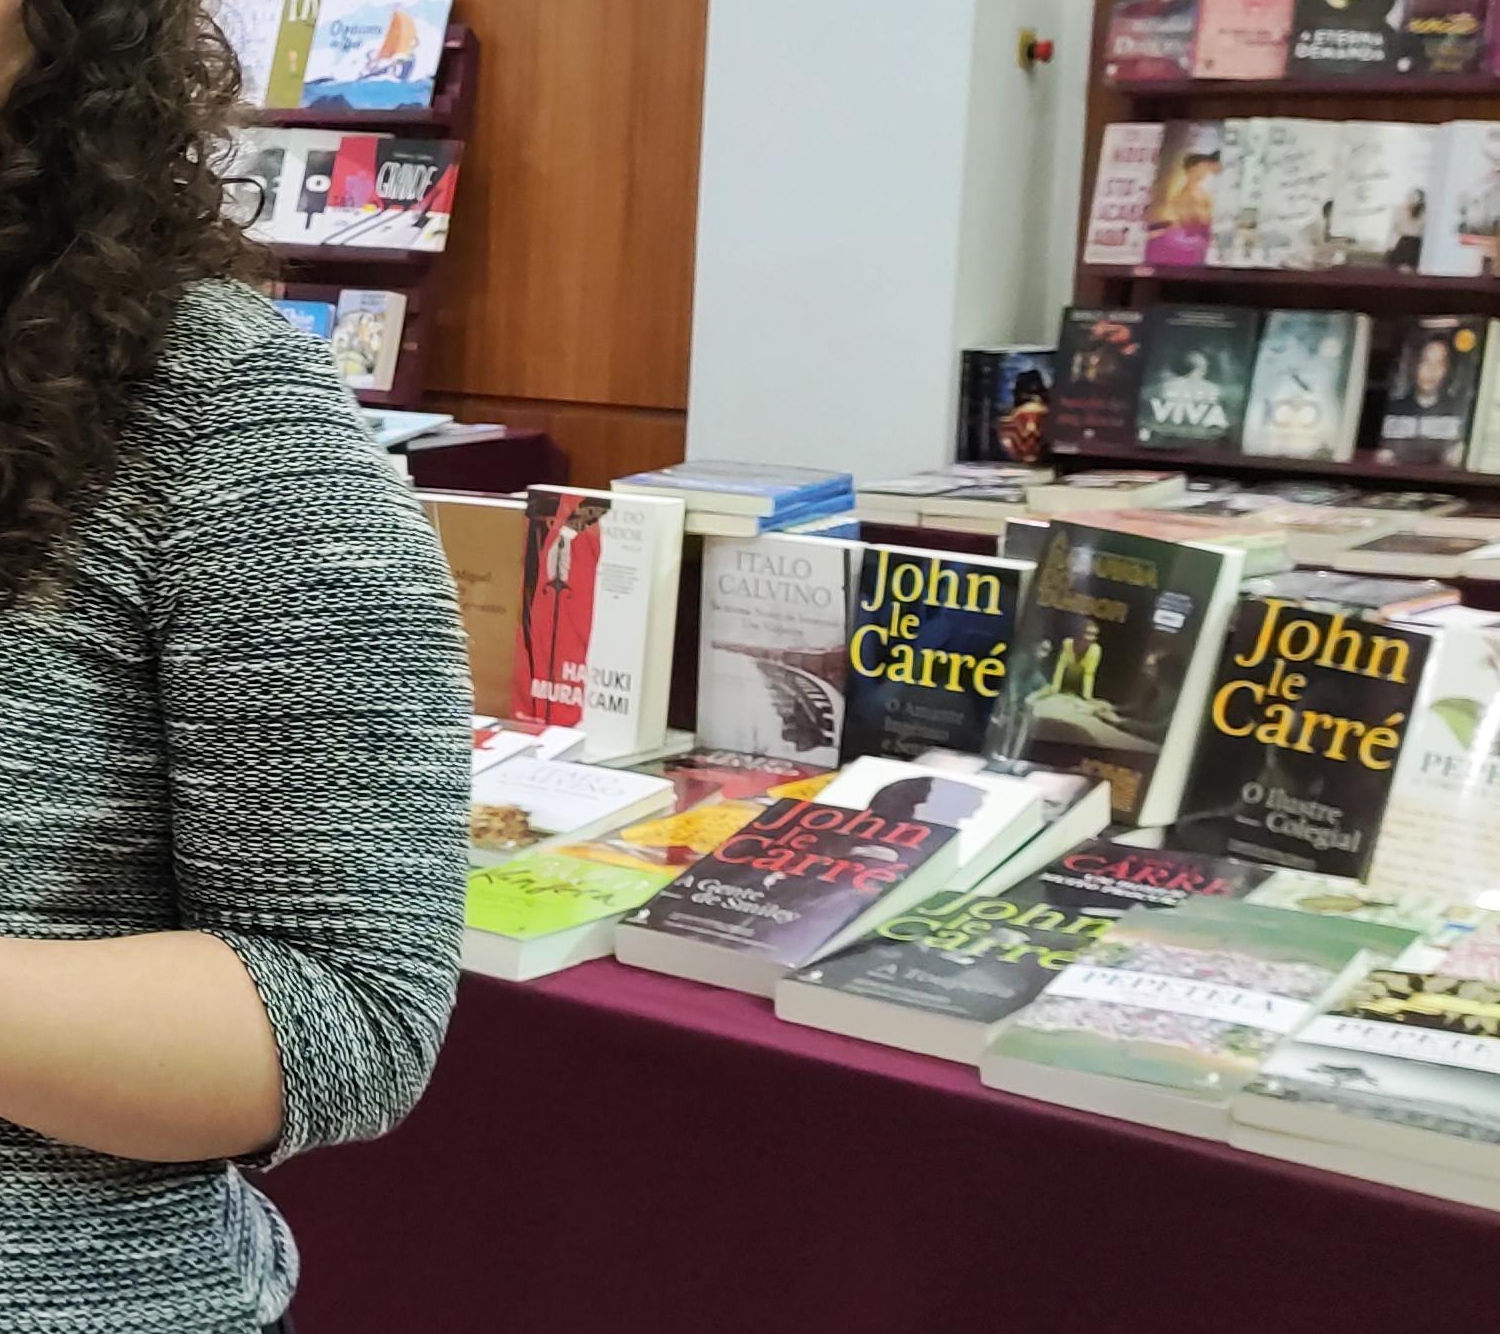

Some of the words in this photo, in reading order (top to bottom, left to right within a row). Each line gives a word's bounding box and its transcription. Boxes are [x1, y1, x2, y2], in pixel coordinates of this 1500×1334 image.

[736, 550, 812, 579] ITALO
[861, 550, 1003, 616] John
[718, 573, 832, 608] CALVINO
[889, 602, 920, 640] le
[850, 624, 1007, 698] Carré
[1235, 599, 1411, 684] John
[562, 661, 632, 691] HARUKI
[1268, 660, 1307, 700] le
[531, 678, 630, 716] MURAKAMI
[1212, 679, 1404, 770] Carré
[1241, 781, 1264, 805] O
[753, 799, 932, 851] John
[786, 826, 818, 850] le
[1266, 807, 1361, 854] Colegial
[916, 897, 1115, 939] John
